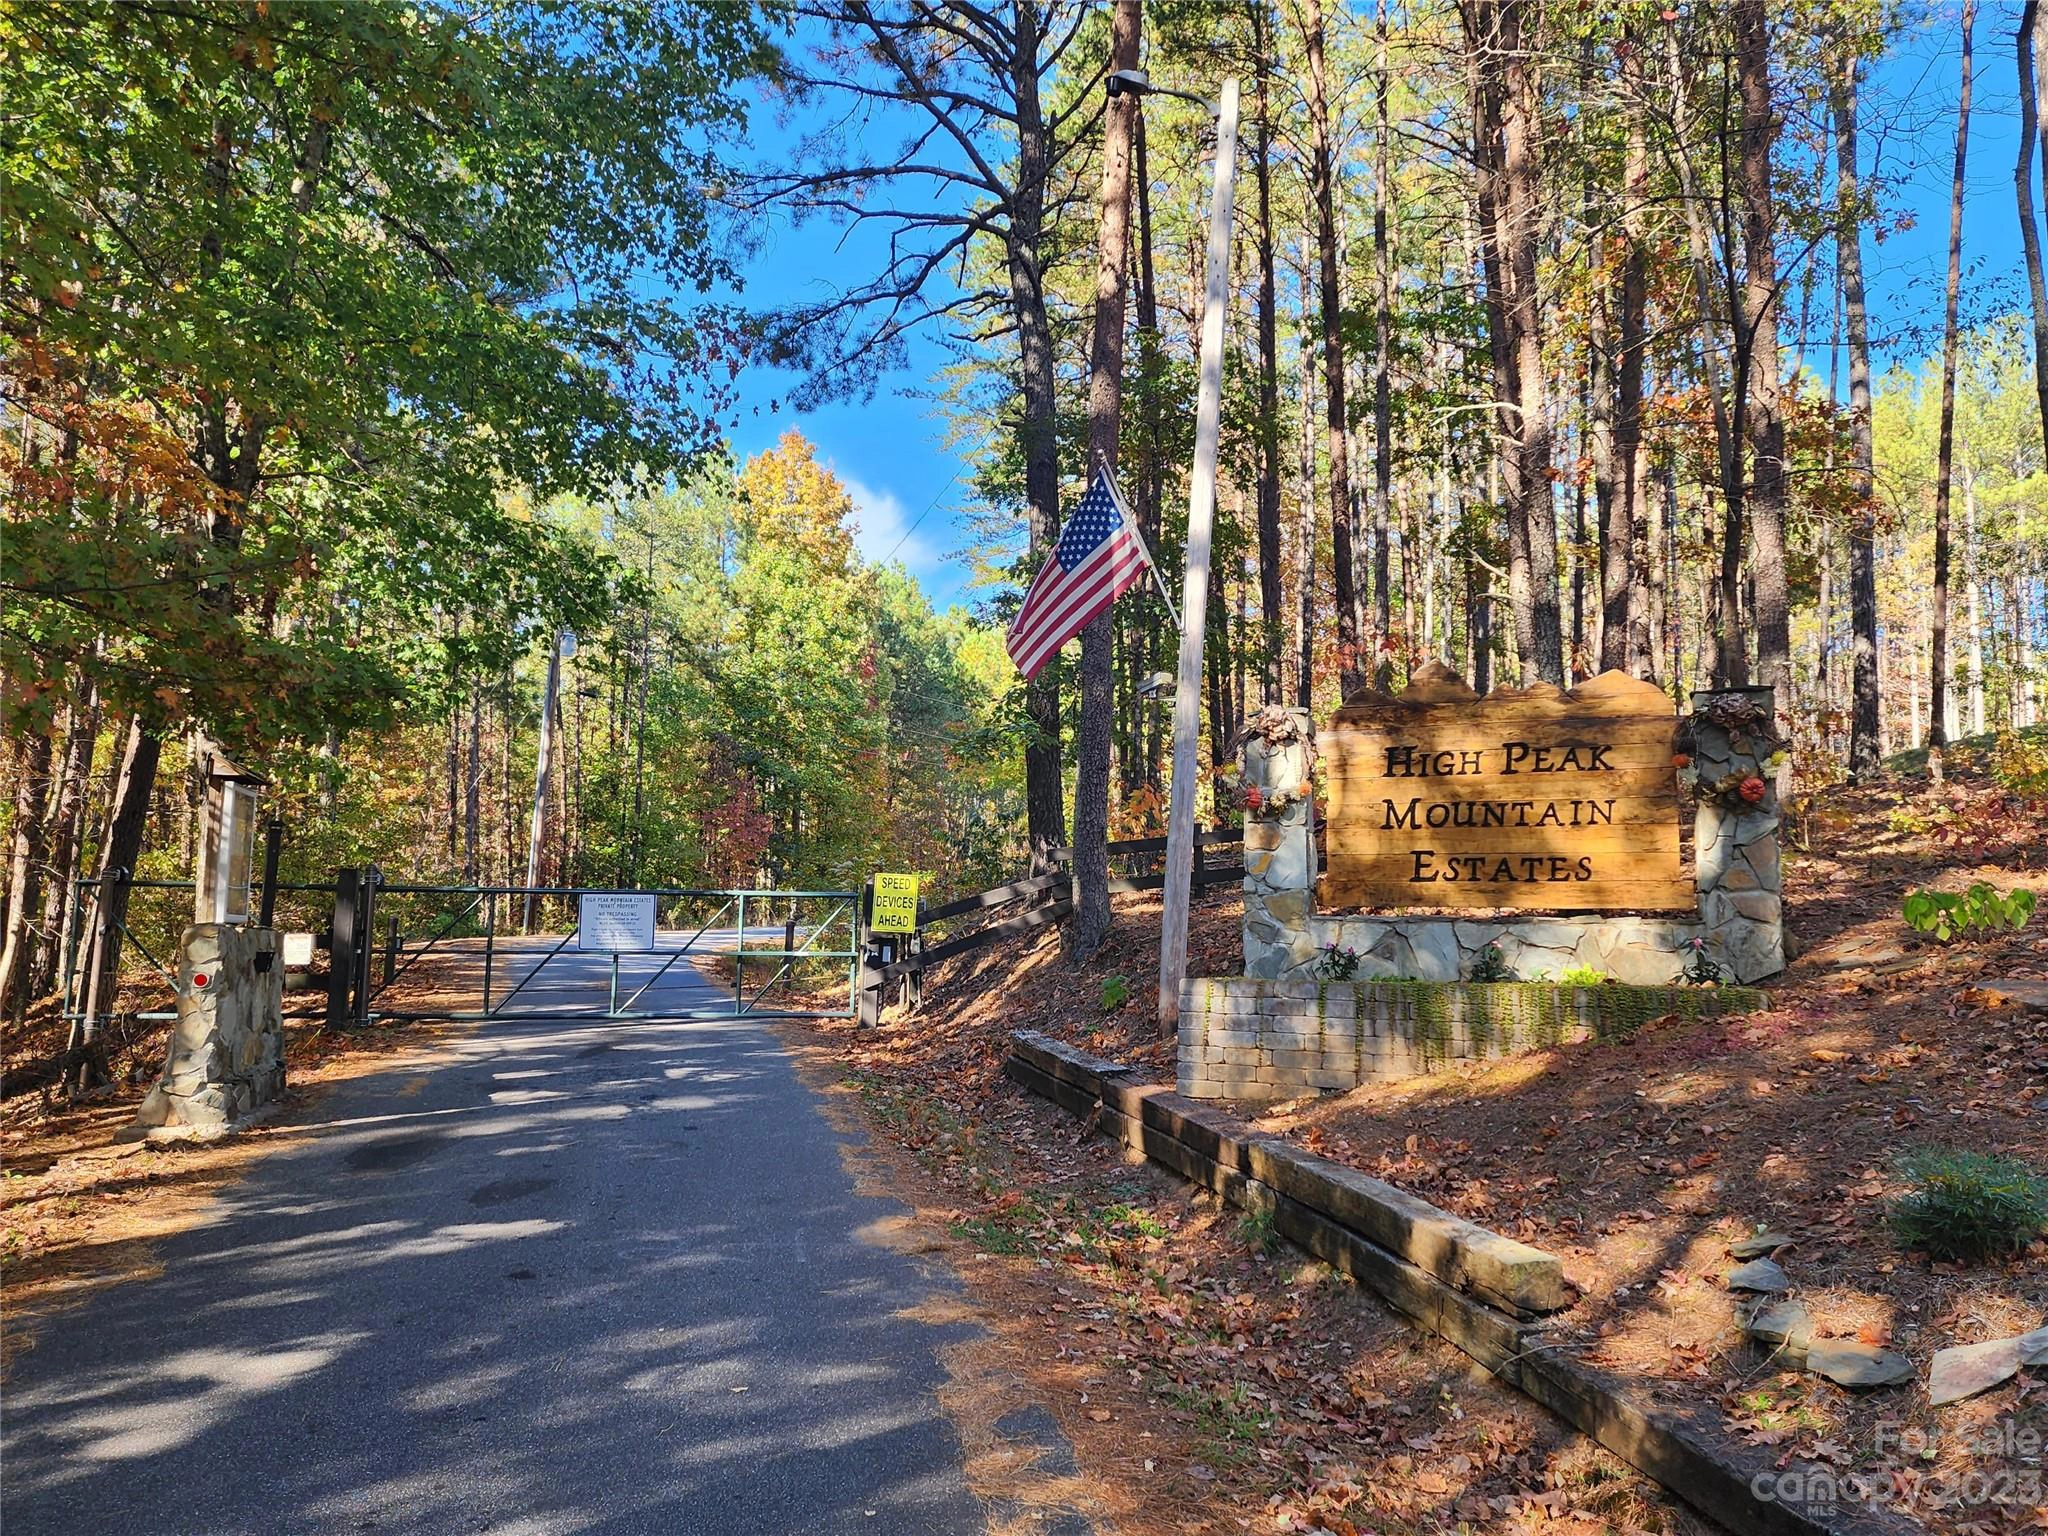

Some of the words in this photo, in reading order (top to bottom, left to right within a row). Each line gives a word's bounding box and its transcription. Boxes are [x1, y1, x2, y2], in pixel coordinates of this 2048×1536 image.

[1381, 744, 1484, 777] HIGH
[1500, 741, 1615, 776] PEAK
[1380, 797, 1617, 830] MOUNTAIN
[1409, 850, 1593, 883] ESTATES
[881, 877, 911, 889] SPEED
[876, 895, 914, 909] DEVICES
[878, 914, 909, 927] AHEAD
